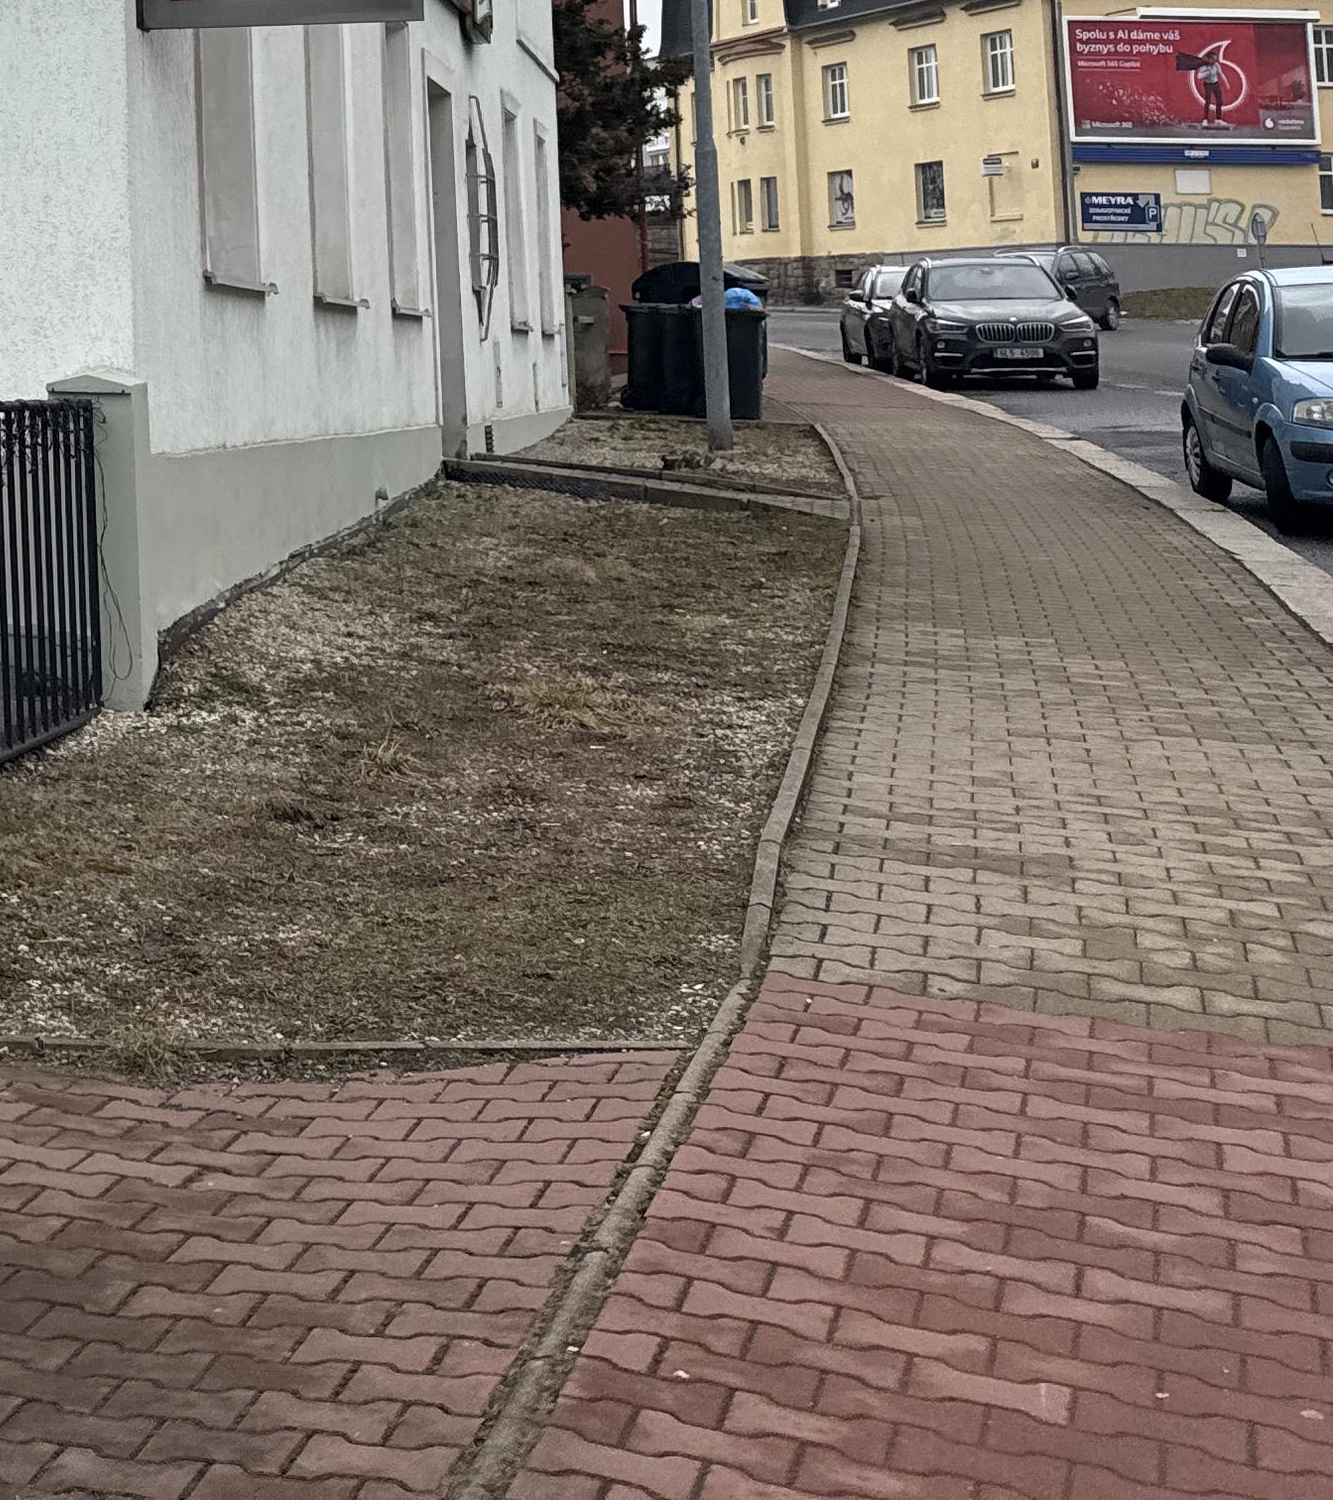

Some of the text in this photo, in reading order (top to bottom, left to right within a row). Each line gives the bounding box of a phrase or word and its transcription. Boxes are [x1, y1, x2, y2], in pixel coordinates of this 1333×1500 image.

[1075, 28, 1107, 40] Spolu
[1108, 31, 1115, 39] s
[1130, 29, 1161, 40] dáme
[1162, 29, 1181, 40] váš
[1076, 42, 1173, 55] byznys do pohybu
[1091, 196, 1134, 205] MEYRA
[1148, 208, 1157, 218] P
